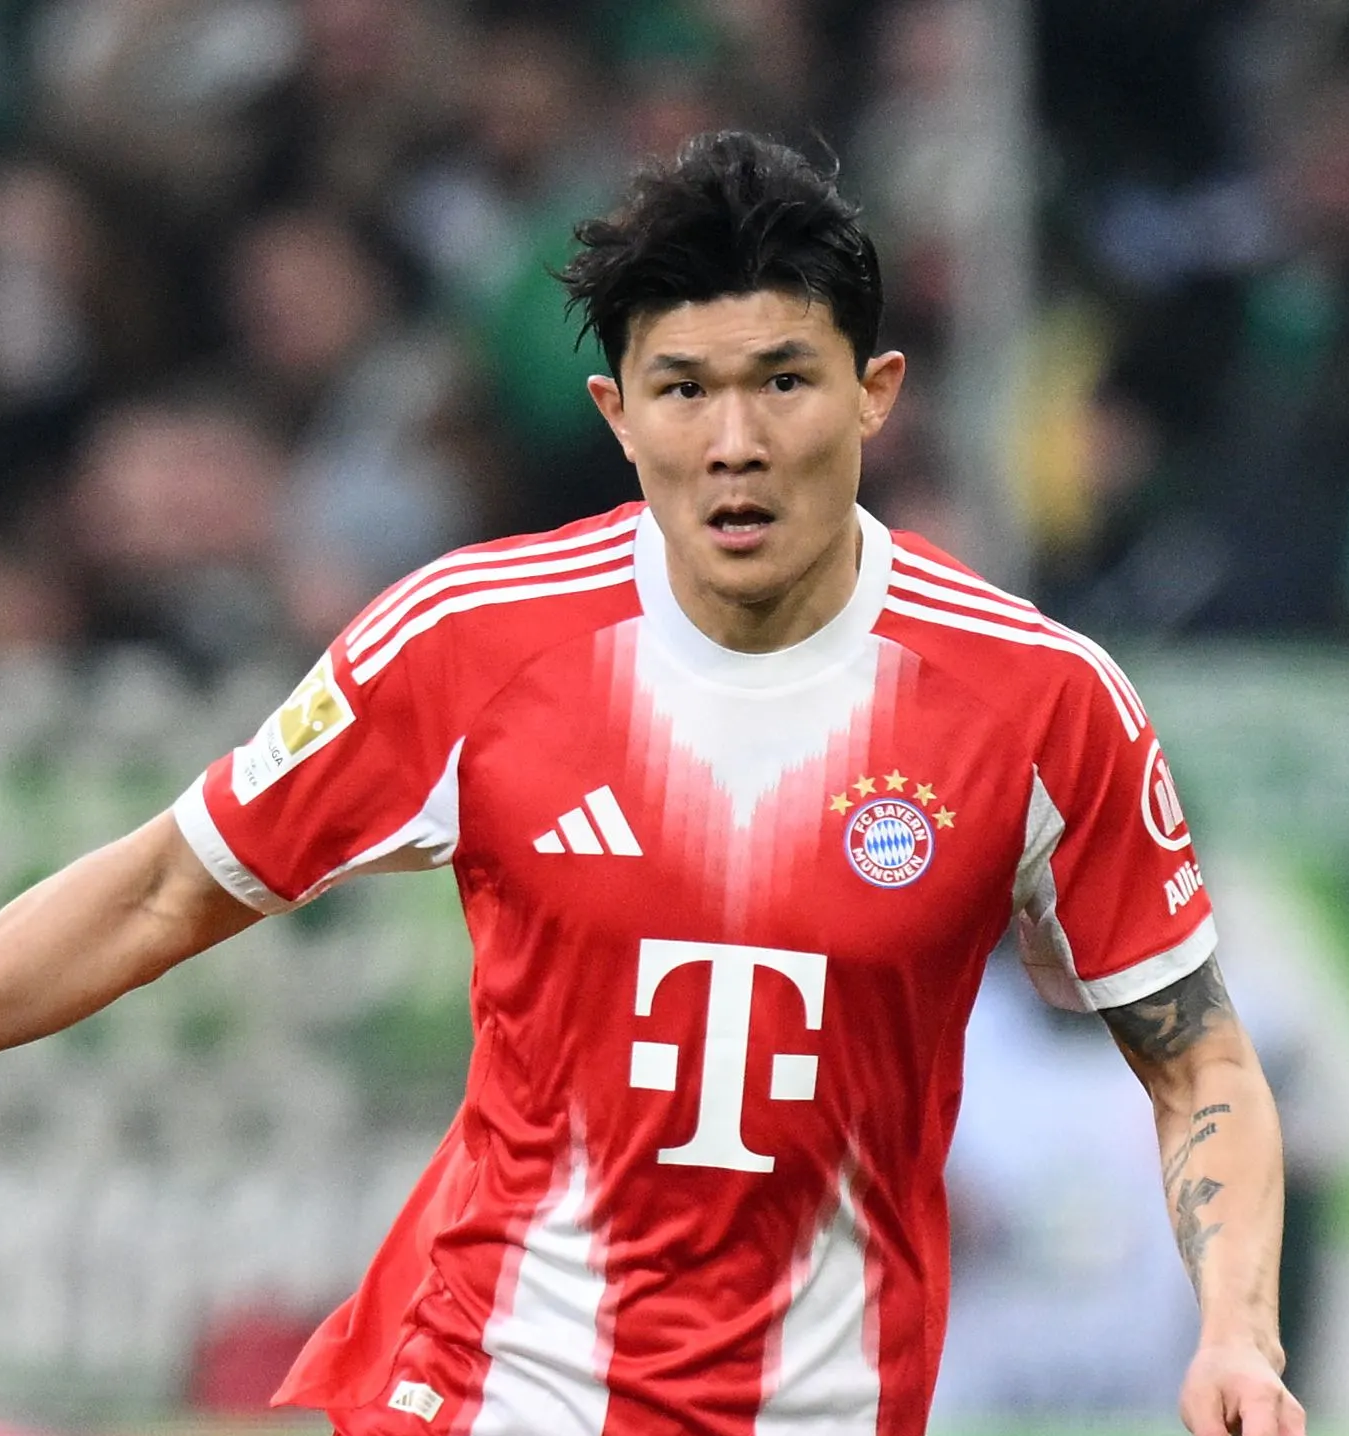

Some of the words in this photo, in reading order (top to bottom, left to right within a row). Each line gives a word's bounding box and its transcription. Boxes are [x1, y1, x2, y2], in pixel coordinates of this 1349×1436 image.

[854, 813, 873, 834] FC
[874, 805, 927, 841] BAYERN
[629, 938, 828, 1174] T
